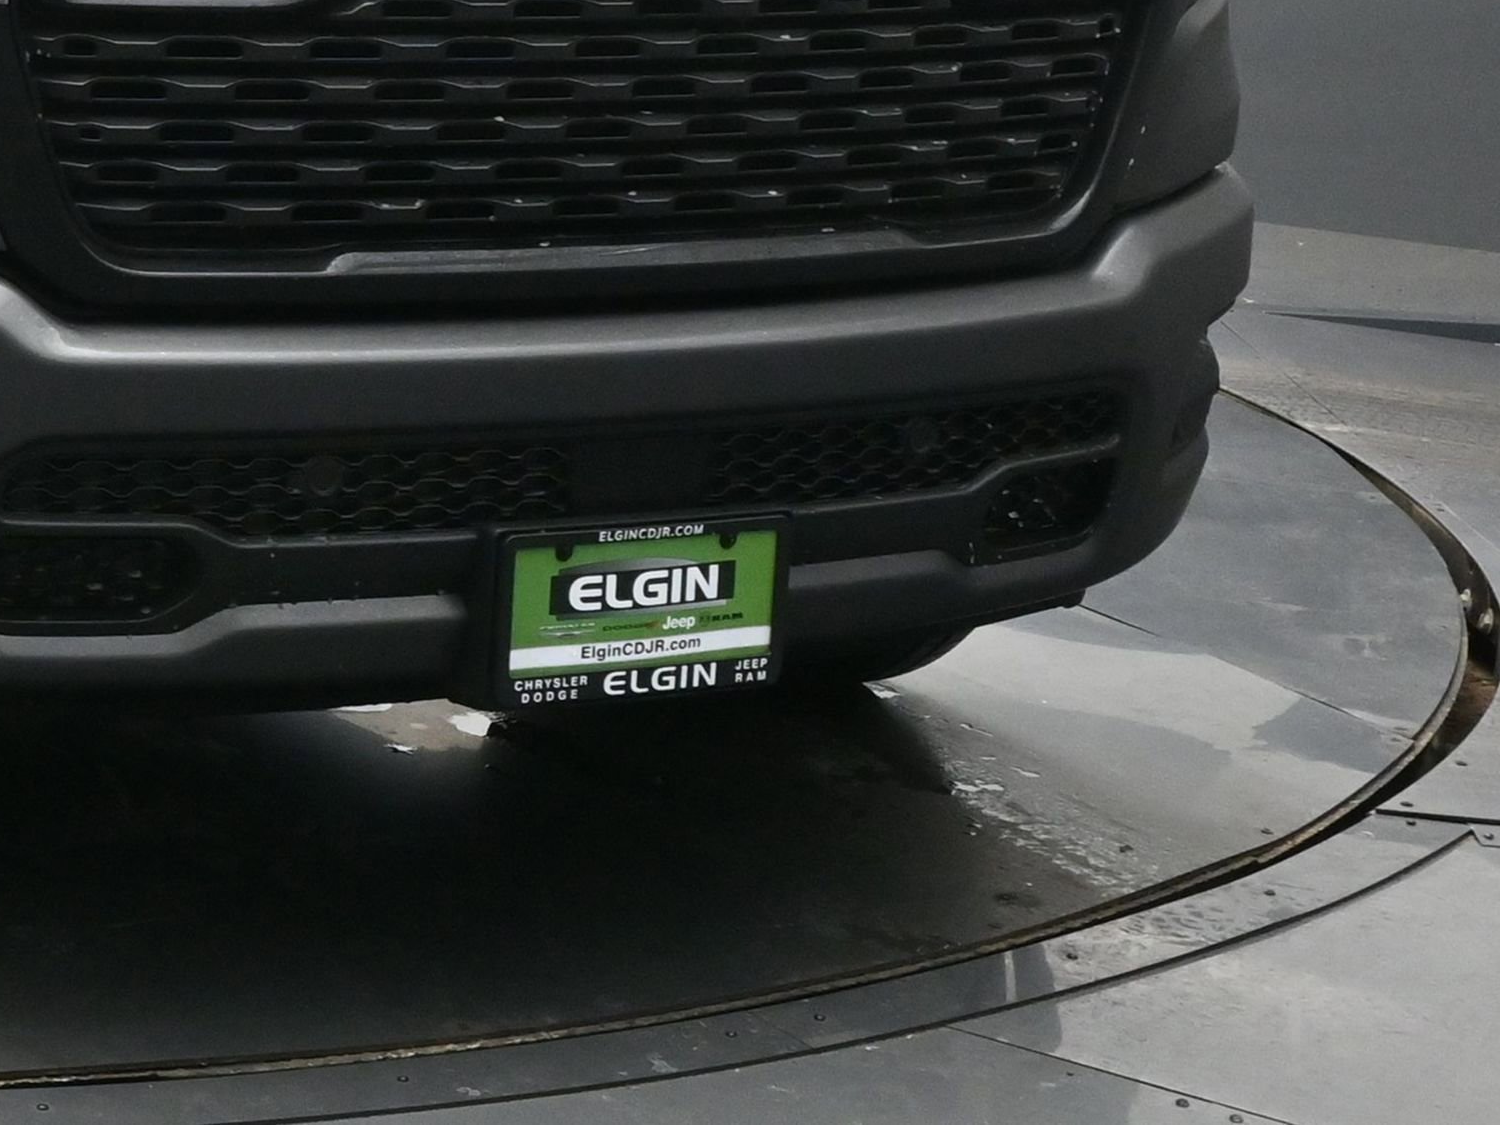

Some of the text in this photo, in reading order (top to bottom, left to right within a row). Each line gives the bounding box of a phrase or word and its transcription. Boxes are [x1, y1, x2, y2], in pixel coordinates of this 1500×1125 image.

[599, 524, 704, 542] ELGINCDJR.COM
[569, 563, 719, 611] ELGIN
[662, 615, 696, 630] Jeep
[581, 638, 701, 661] ElginCDJR.com
[735, 658, 768, 671] JEEP
[514, 676, 588, 692] CHRYSLER
[603, 662, 717, 695] ELGIN
[735, 671, 767, 683] RAM
[521, 689, 578, 704] DODGE
